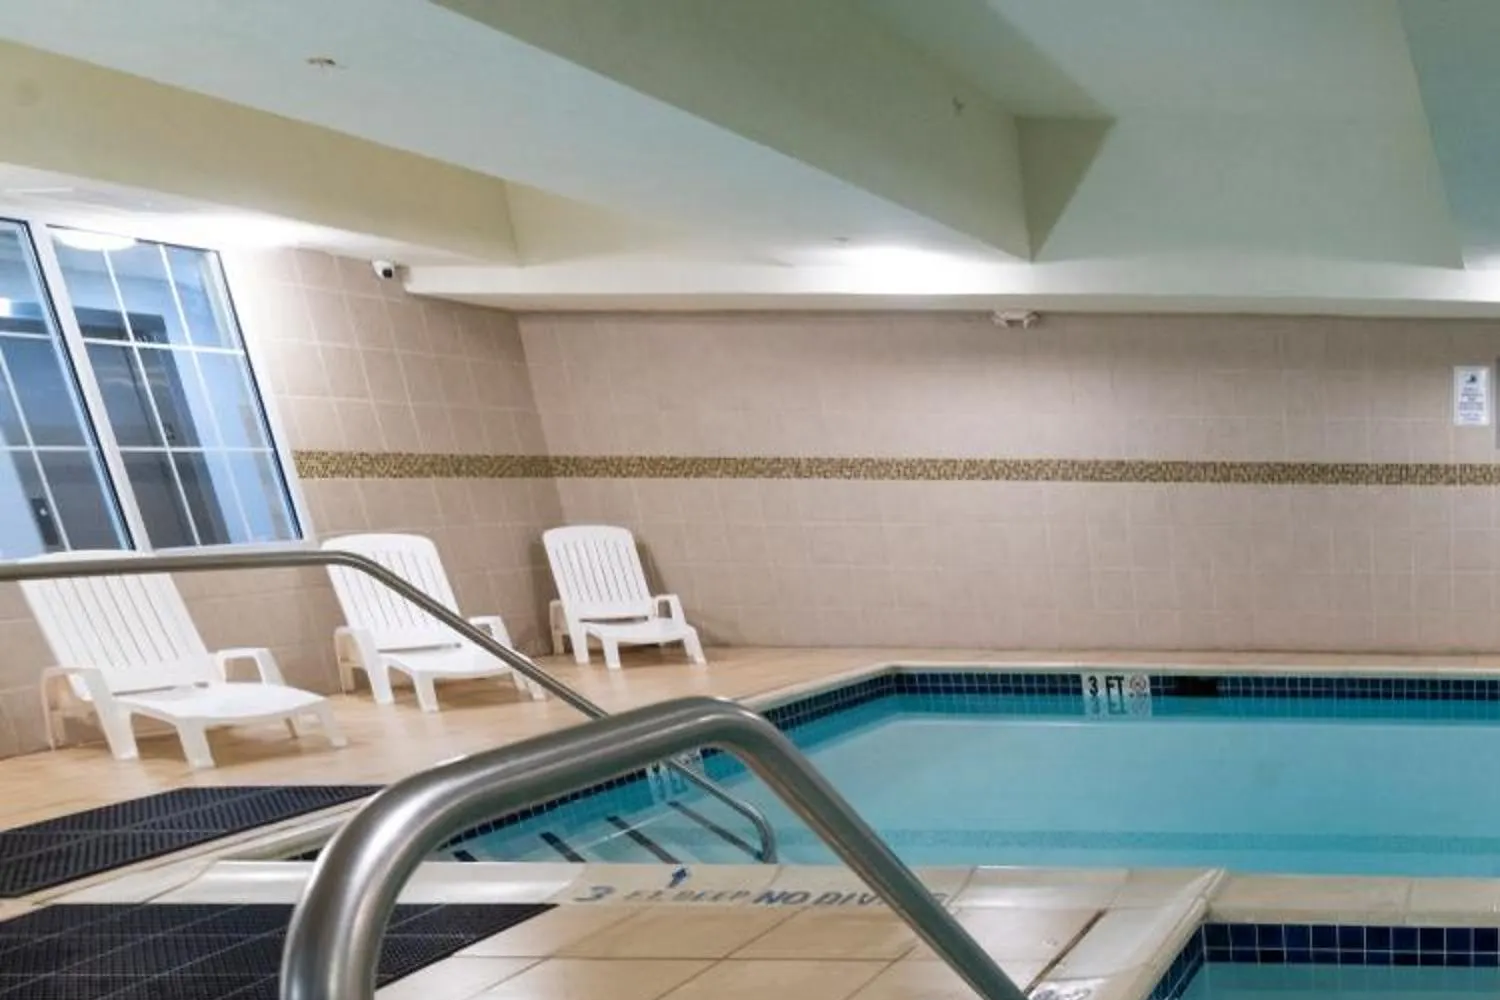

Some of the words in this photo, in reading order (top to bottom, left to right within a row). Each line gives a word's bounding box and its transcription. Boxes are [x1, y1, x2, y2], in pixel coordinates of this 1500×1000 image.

[1088, 675, 1099, 697] 3
[1105, 676, 1125, 698] FT
[752, 889, 812, 905] NO
